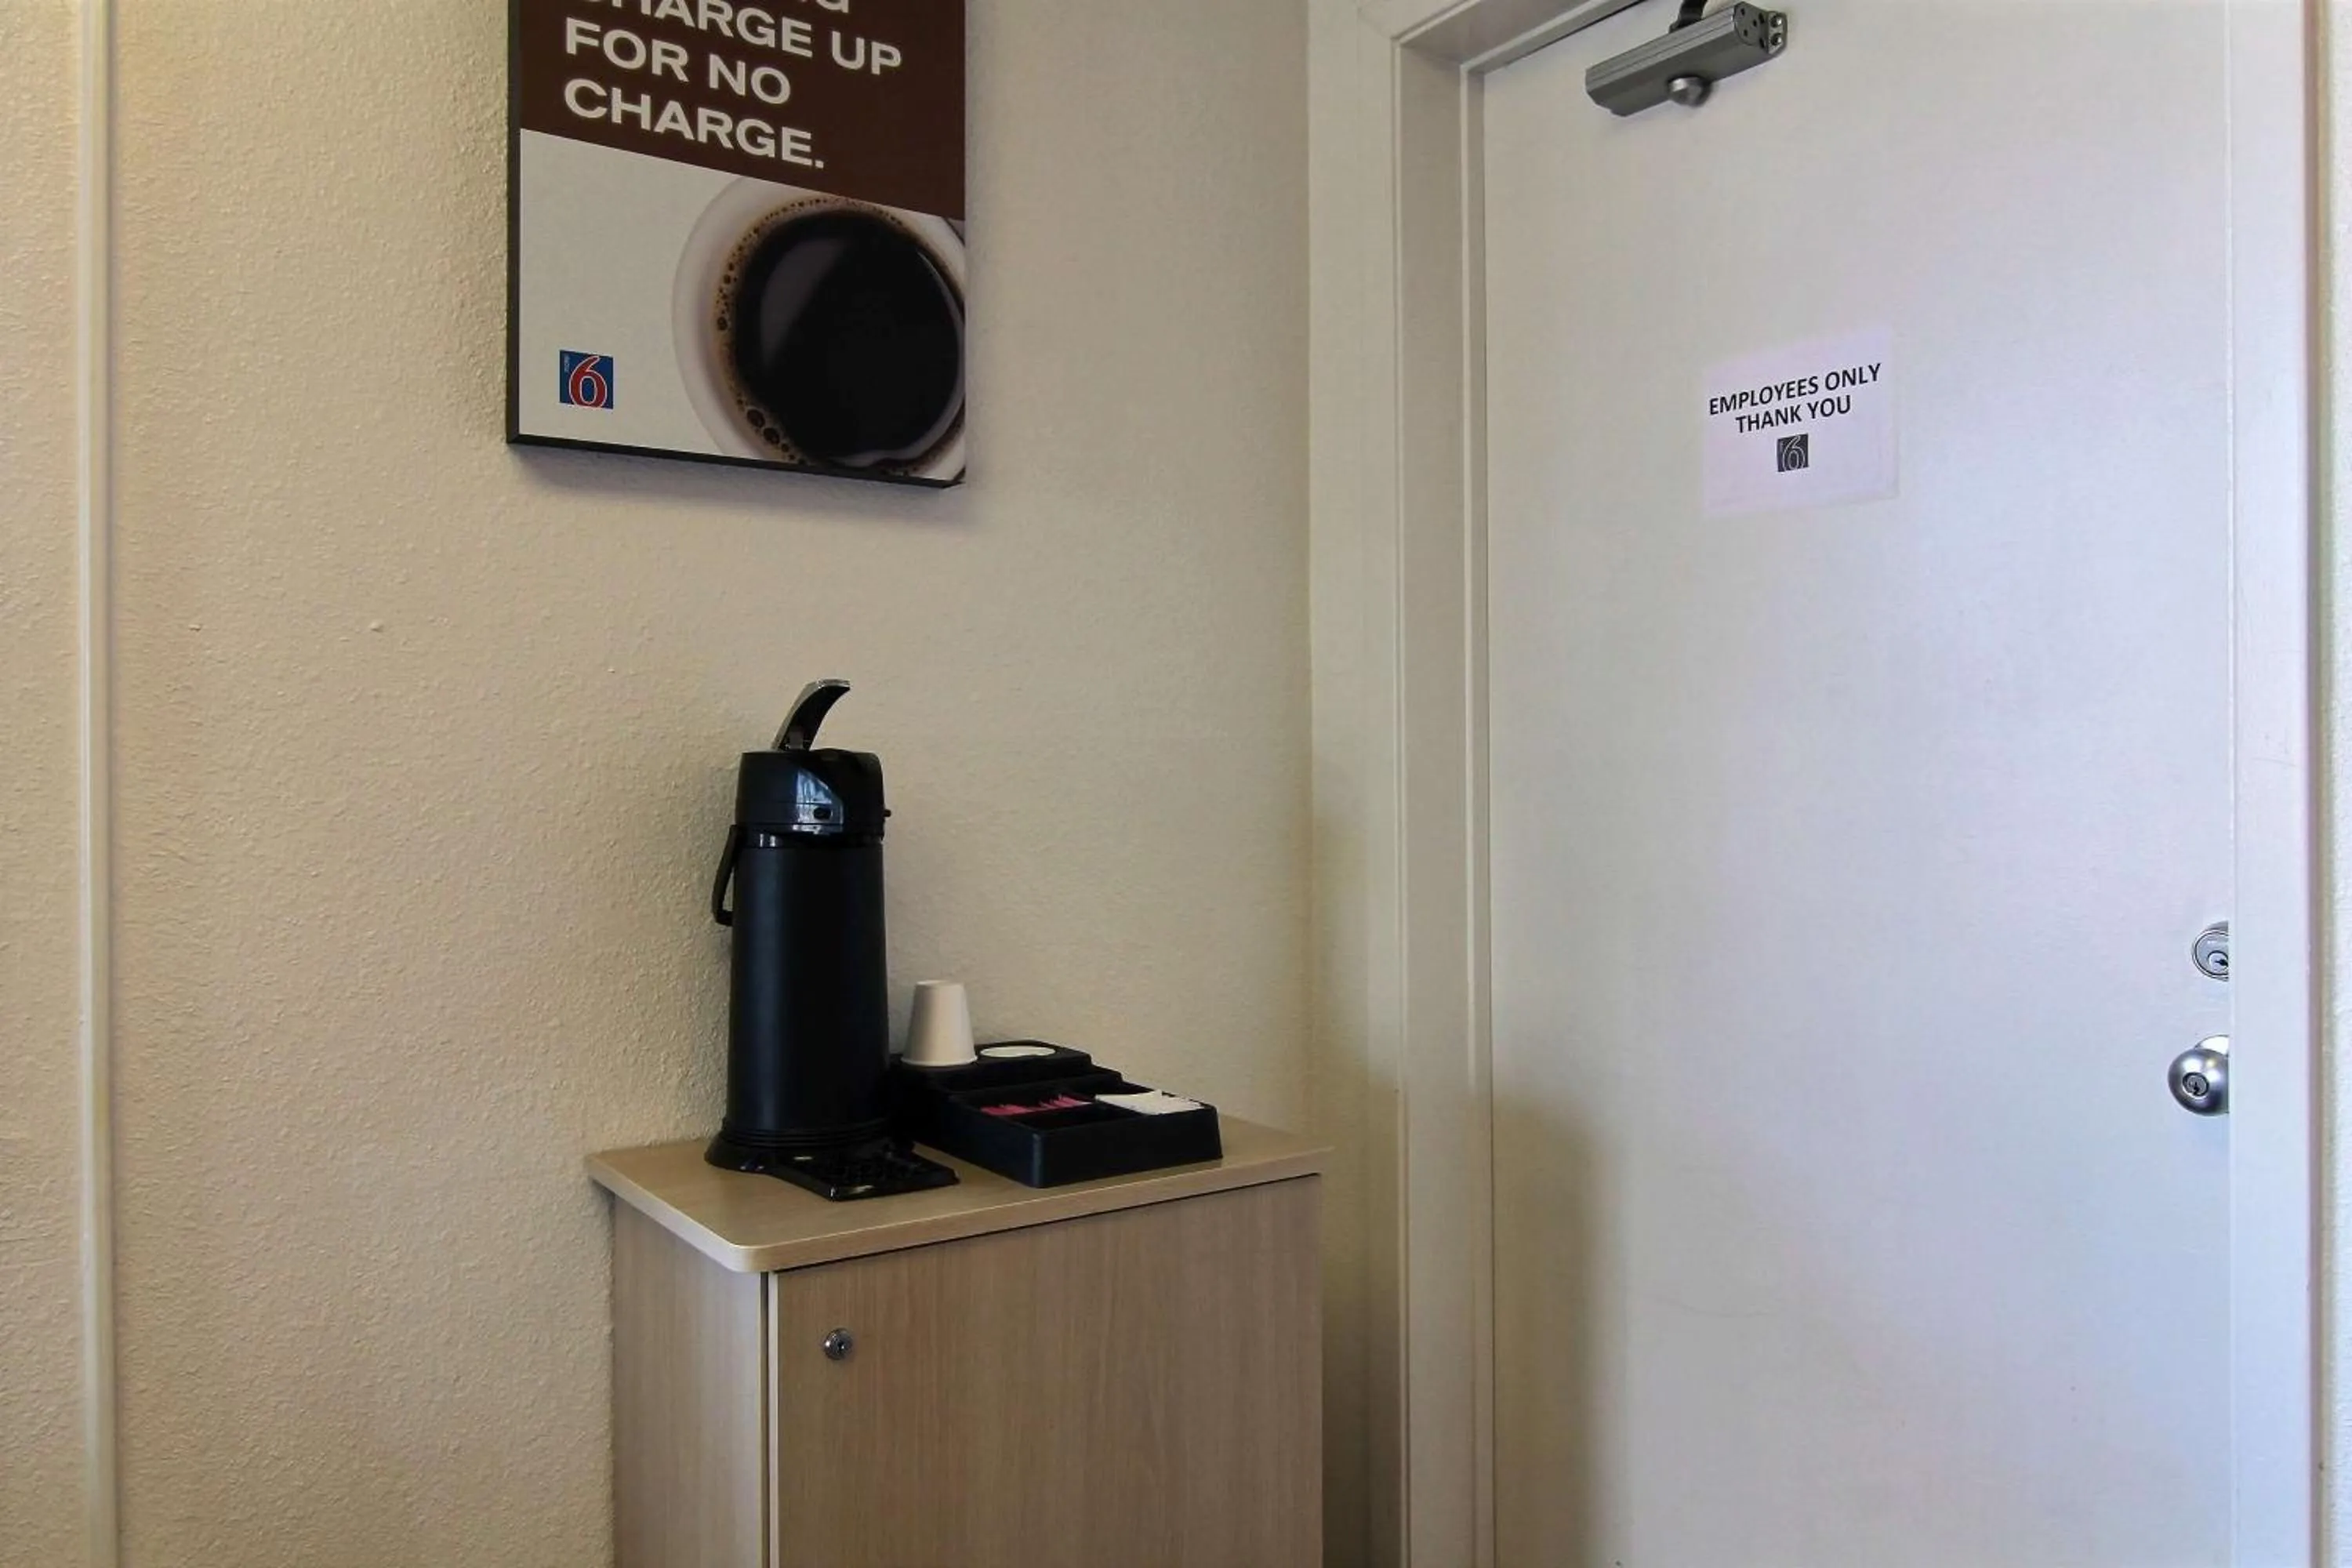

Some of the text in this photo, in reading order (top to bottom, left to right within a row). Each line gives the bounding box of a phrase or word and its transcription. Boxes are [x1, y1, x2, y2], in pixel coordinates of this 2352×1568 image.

[566, 16, 790, 103] FOR NO
[586, 0, 901, 74] ARGE UP
[564, 78, 824, 169] CHARGE.
[568, 355, 607, 408] 6
[1709, 362, 1882, 416] EMPLOYEES ONLY
[1736, 395, 1851, 433] THANK YOU
[1783, 434, 1805, 470] 6
